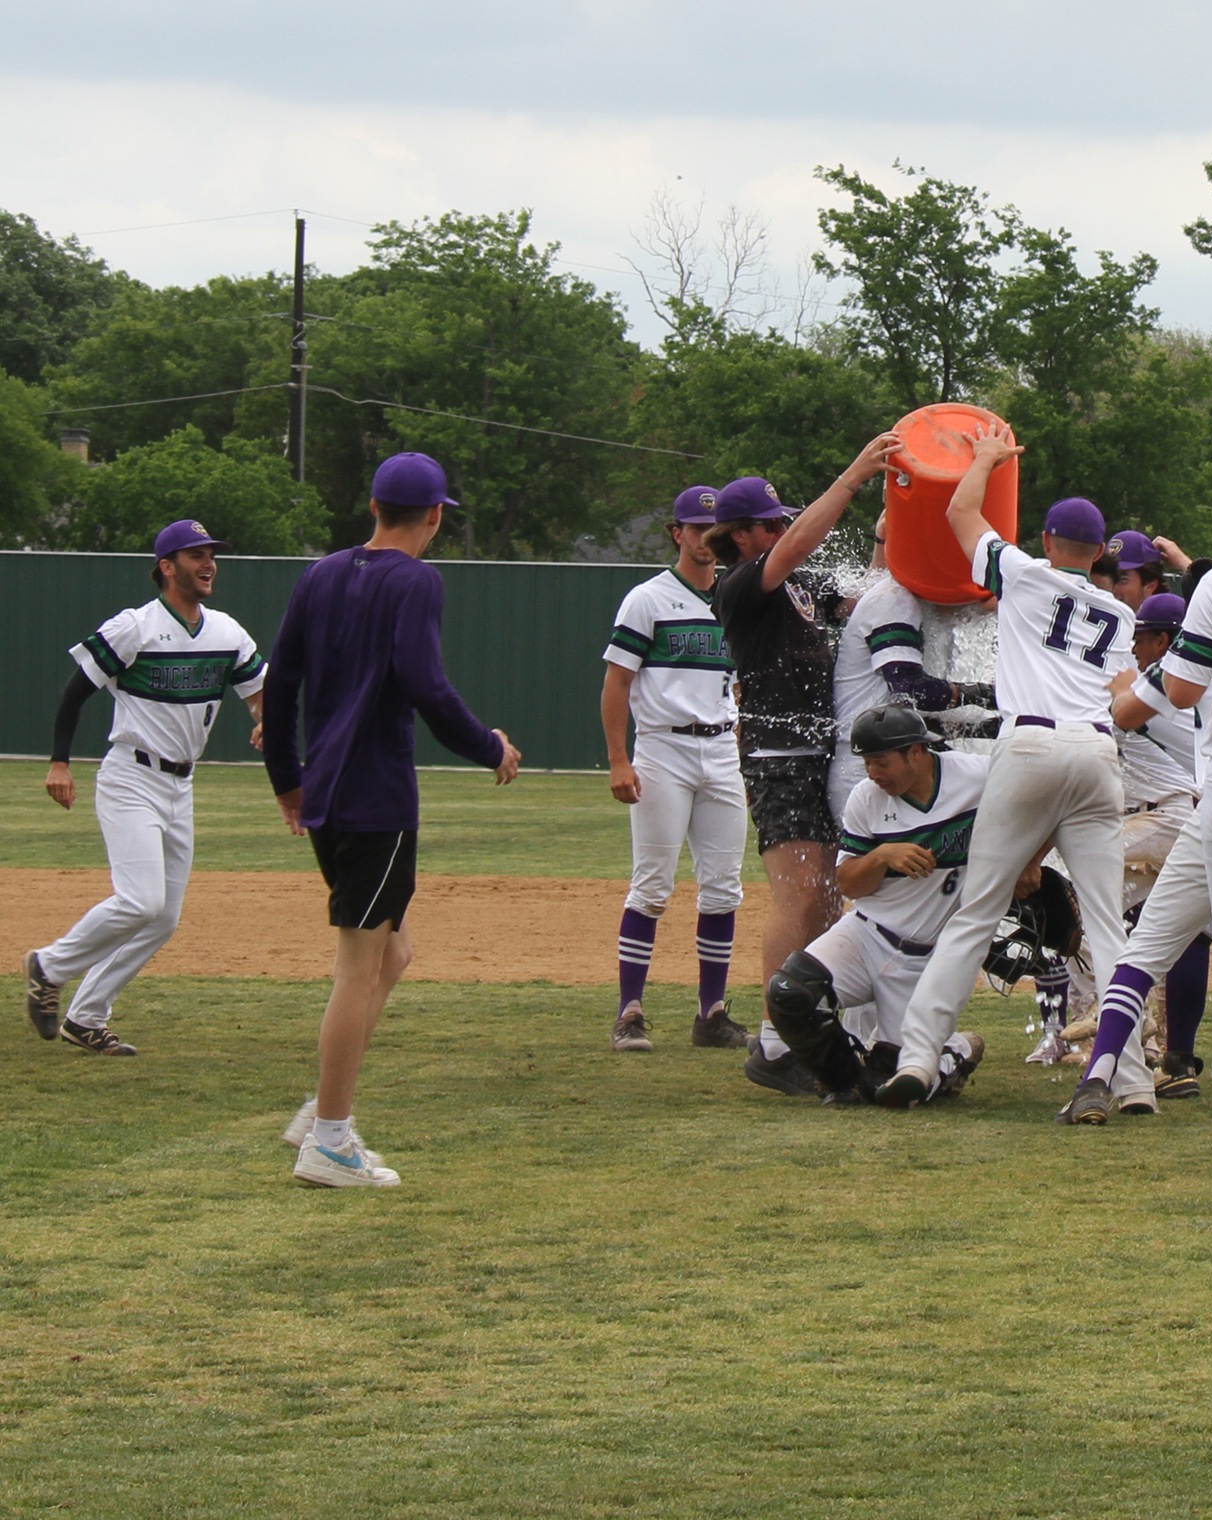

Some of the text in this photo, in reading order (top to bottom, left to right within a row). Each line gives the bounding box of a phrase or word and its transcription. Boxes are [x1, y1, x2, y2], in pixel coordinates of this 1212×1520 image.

[667, 632, 731, 658] RICHLA
[1042, 593, 1121, 673] 17
[149, 664, 228, 691] RICHLAN
[203, 703, 213, 727] 8
[942, 868, 958, 897] 6
